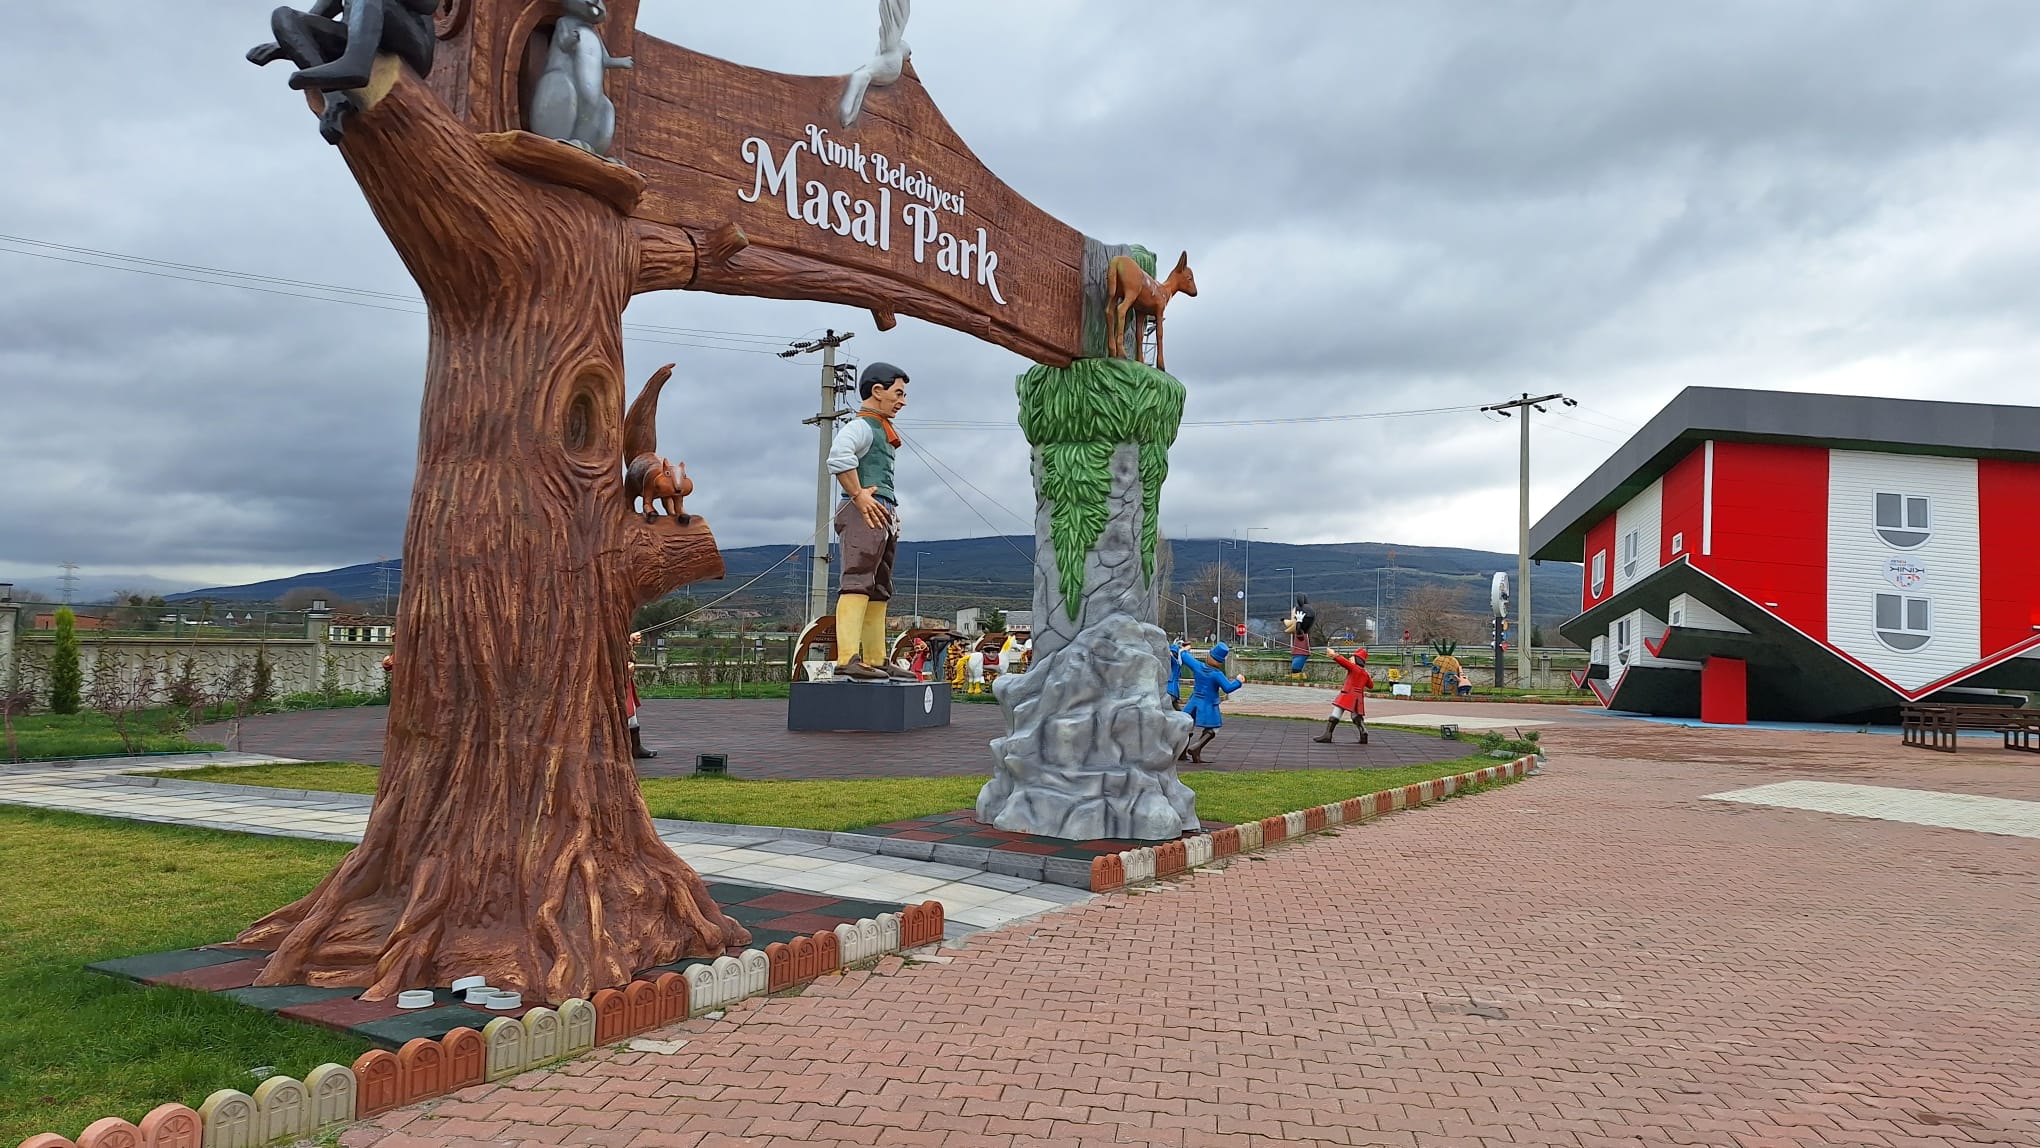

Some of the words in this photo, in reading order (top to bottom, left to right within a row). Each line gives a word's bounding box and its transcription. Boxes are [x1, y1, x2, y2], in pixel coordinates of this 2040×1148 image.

[737, 136, 891, 252] Masal
[902, 203, 1007, 305] Park
[805, 123, 870, 183] Kınık
[870, 152, 965, 216] Belediyesi
